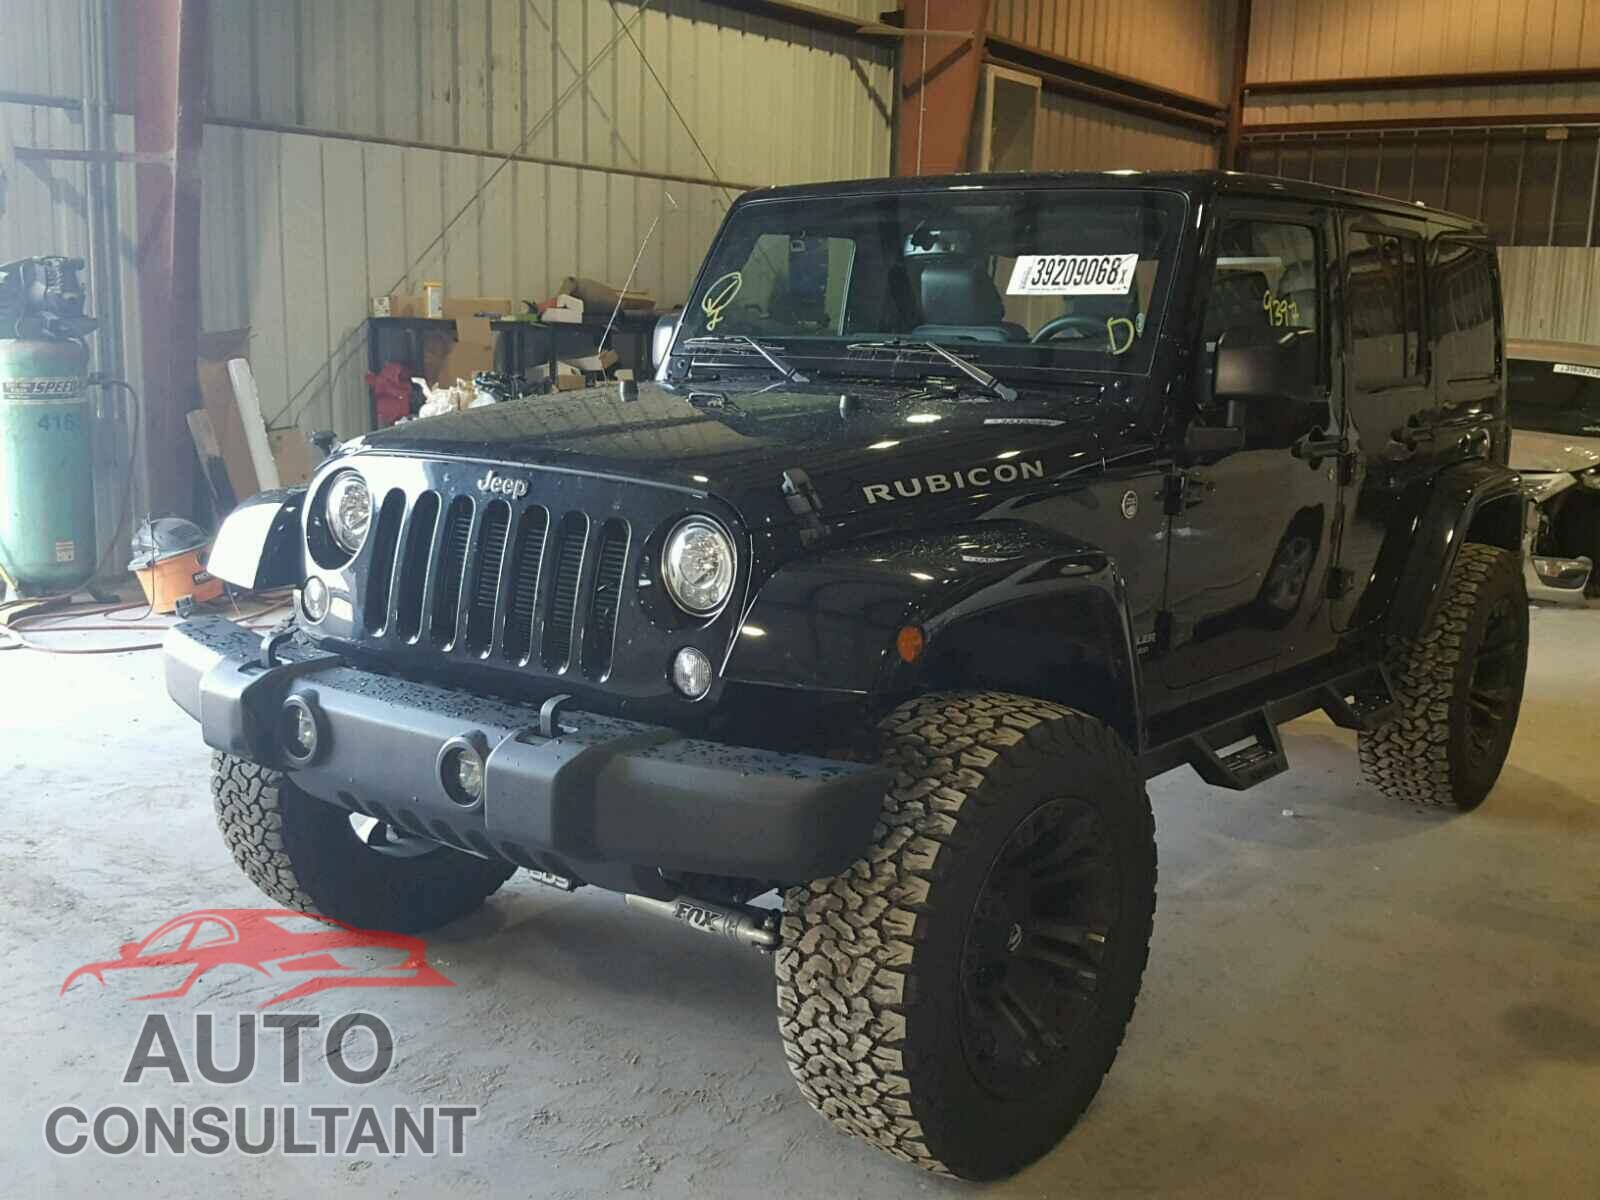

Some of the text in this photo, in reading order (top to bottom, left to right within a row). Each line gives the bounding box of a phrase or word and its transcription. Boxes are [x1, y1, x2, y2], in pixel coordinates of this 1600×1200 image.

[1031, 256, 1122, 287] 39209068
[477, 469, 529, 500] Jeep
[862, 460, 1045, 504] RUBICON
[674, 902, 723, 932] FOX
